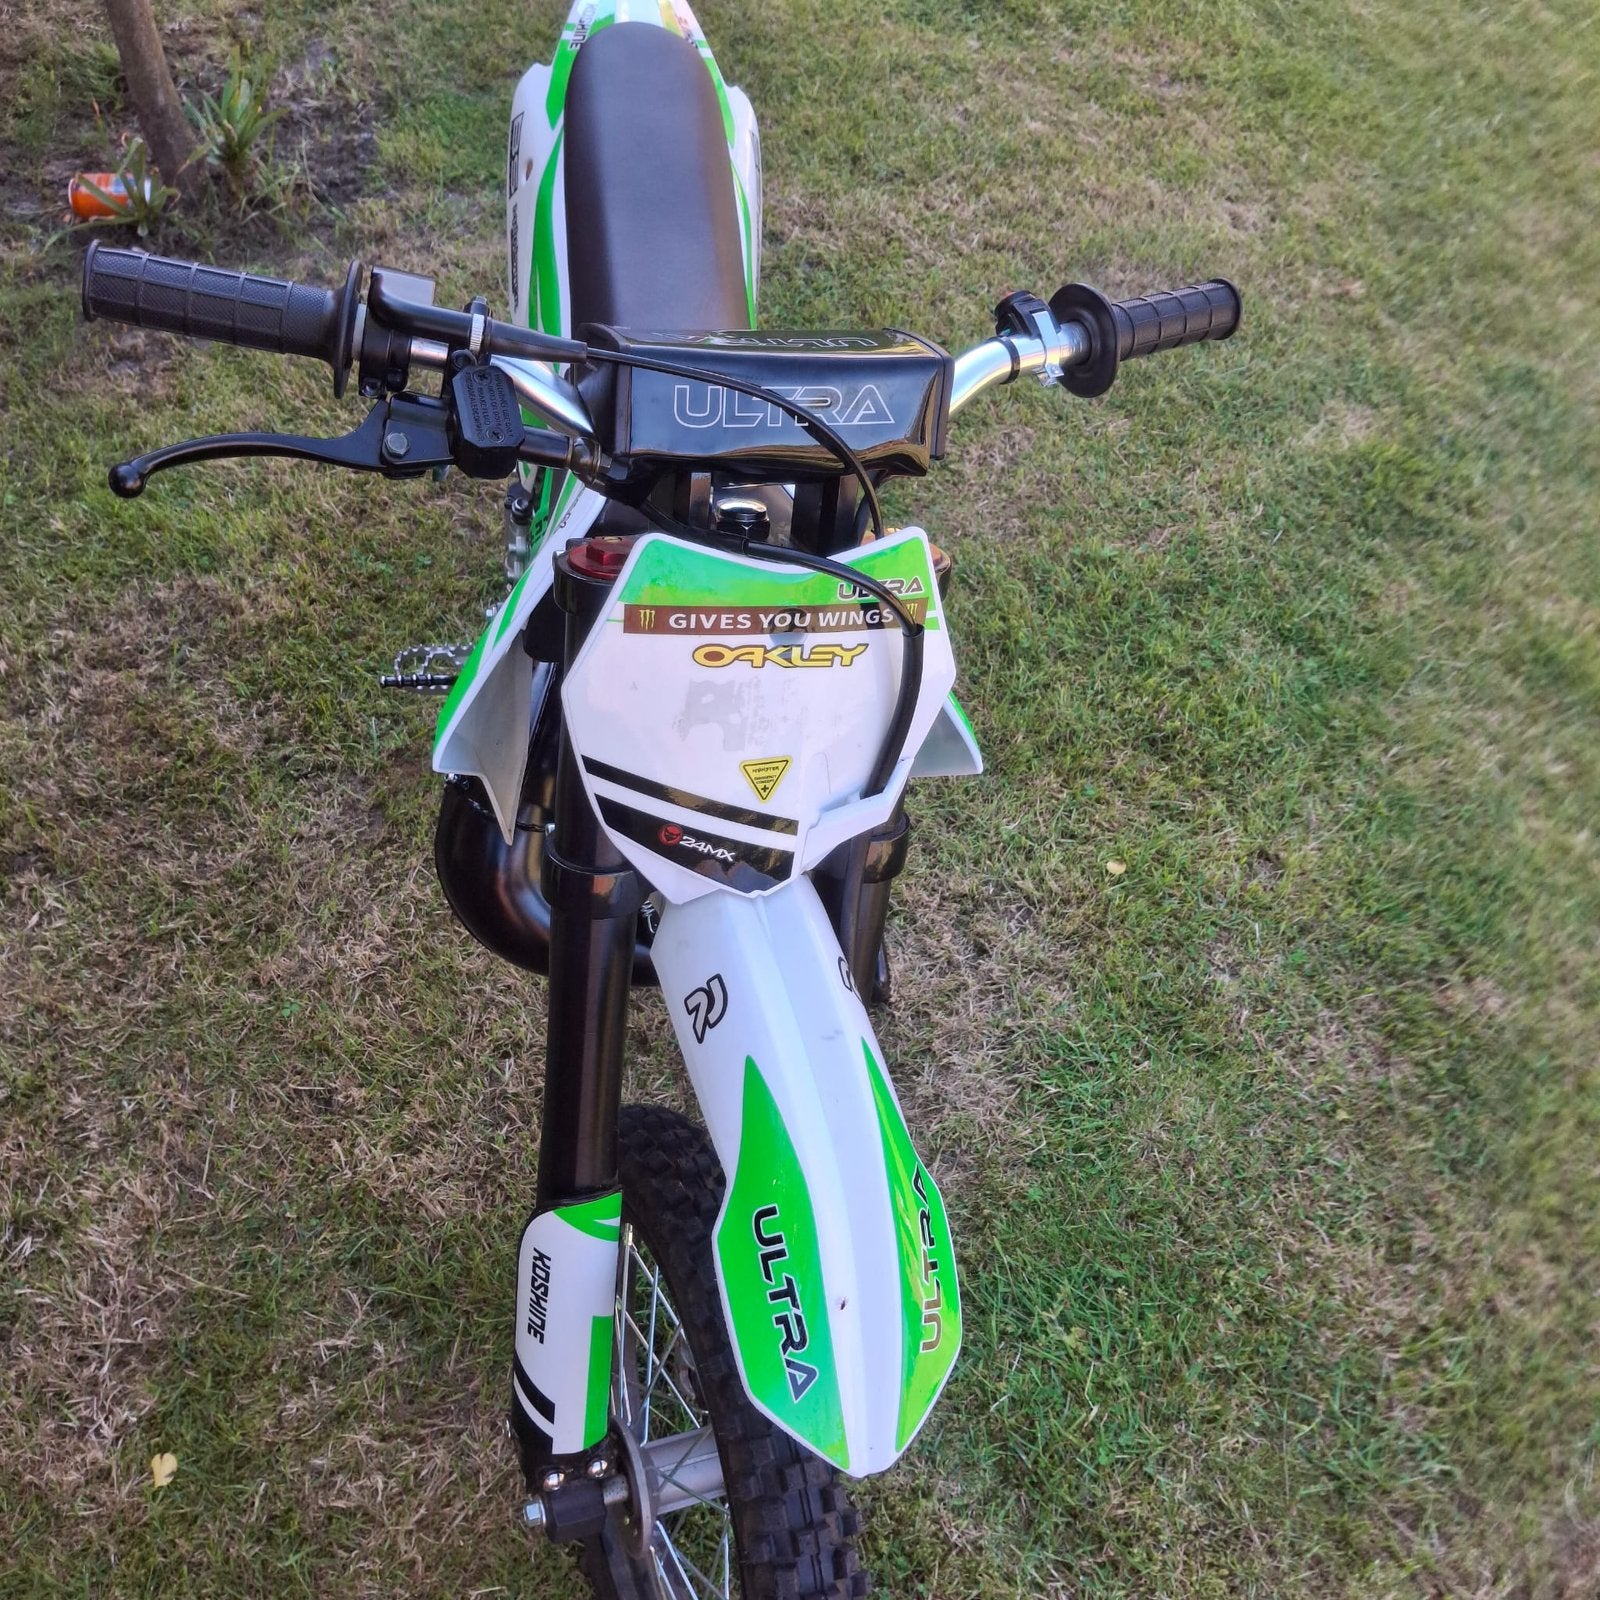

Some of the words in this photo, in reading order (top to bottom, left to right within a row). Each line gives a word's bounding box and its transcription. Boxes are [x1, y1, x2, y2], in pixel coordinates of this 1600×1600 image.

[669, 613, 751, 629] GIVES
[758, 612, 811, 628] YOU
[818, 608, 894, 627] WINGS
[692, 643, 869, 668] OAKLEY
[680, 835, 736, 862] 24MX
[912, 1161, 942, 1353] ULTRA
[527, 1247, 552, 1344] KOSHINE
[752, 1203, 819, 1404] ULTRA
